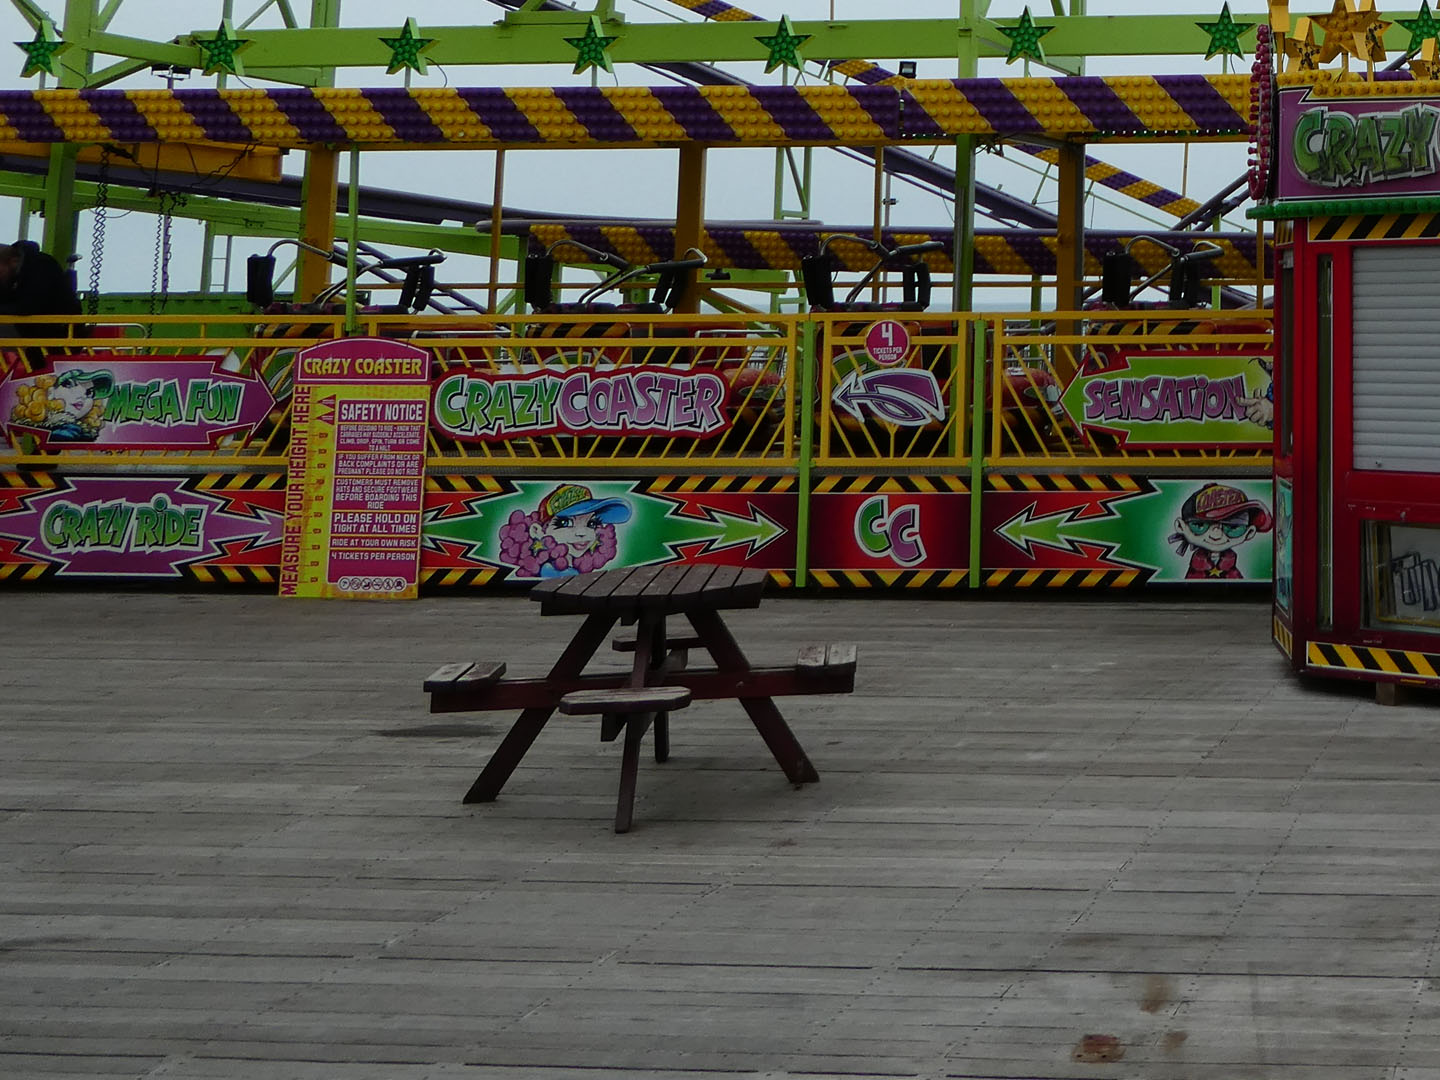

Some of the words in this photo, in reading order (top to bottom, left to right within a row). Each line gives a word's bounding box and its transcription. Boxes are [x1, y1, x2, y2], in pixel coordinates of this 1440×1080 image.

[1293, 103, 1438, 188] CRAZY
[882, 323, 893, 346] 4
[303, 357, 352, 376] CRAZY
[354, 357, 422, 376] COASTER
[105, 380, 188, 428] MEGA
[185, 378, 245, 424] FUN
[292, 386, 311, 423] HERE
[341, 404, 382, 420] SAFETY
[384, 404, 424, 420] NOTICE
[435, 374, 561, 436] CRAZY
[560, 373, 728, 436] COASTER
[289, 428, 308, 479] HEIGHT
[286, 484, 304, 520] YOUR
[334, 513, 373, 523] PLEASE
[375, 513, 400, 523] HOLD
[403, 513, 416, 523] ON
[40, 500, 131, 553] CRAZY
[334, 525, 358, 533] TIGHT
[359, 525, 370, 533] AT
[372, 525, 388, 533] ALL
[391, 525, 416, 533] TIMES
[854, 495, 927, 567] CC
[281, 525, 301, 595] MEASURE
[332, 552, 336, 560] 4
[338, 552, 369, 560] TICKETS
[370, 552, 385, 560] PER
[386, 552, 415, 560] PERSON
